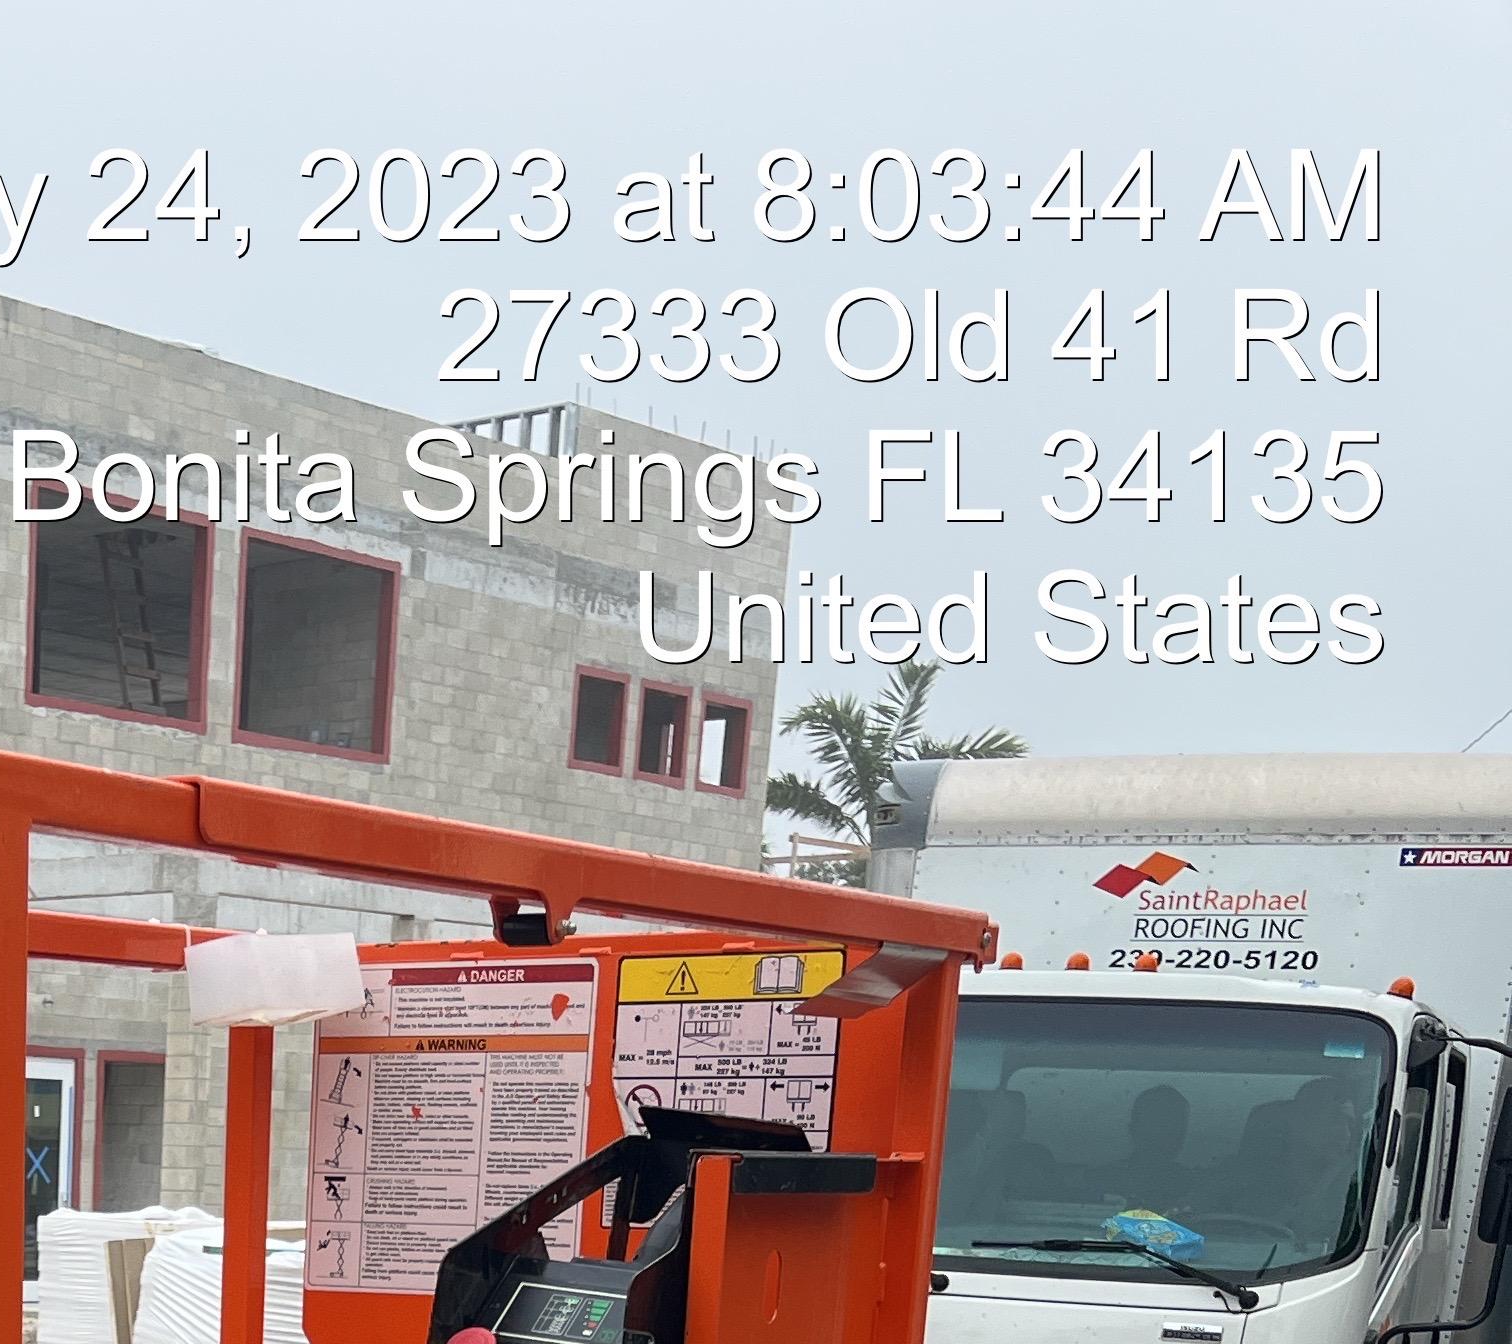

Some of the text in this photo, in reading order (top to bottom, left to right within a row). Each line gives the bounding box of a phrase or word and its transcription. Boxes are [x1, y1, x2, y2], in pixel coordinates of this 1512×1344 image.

[1419, 849, 1510, 865] MORGAN
[1137, 888, 1309, 915] SaintRaphael
[1133, 918, 1305, 940] ROOFING INC
[470, 969, 525, 983] DANGER
[427, 1038, 487, 1052] WARNING
